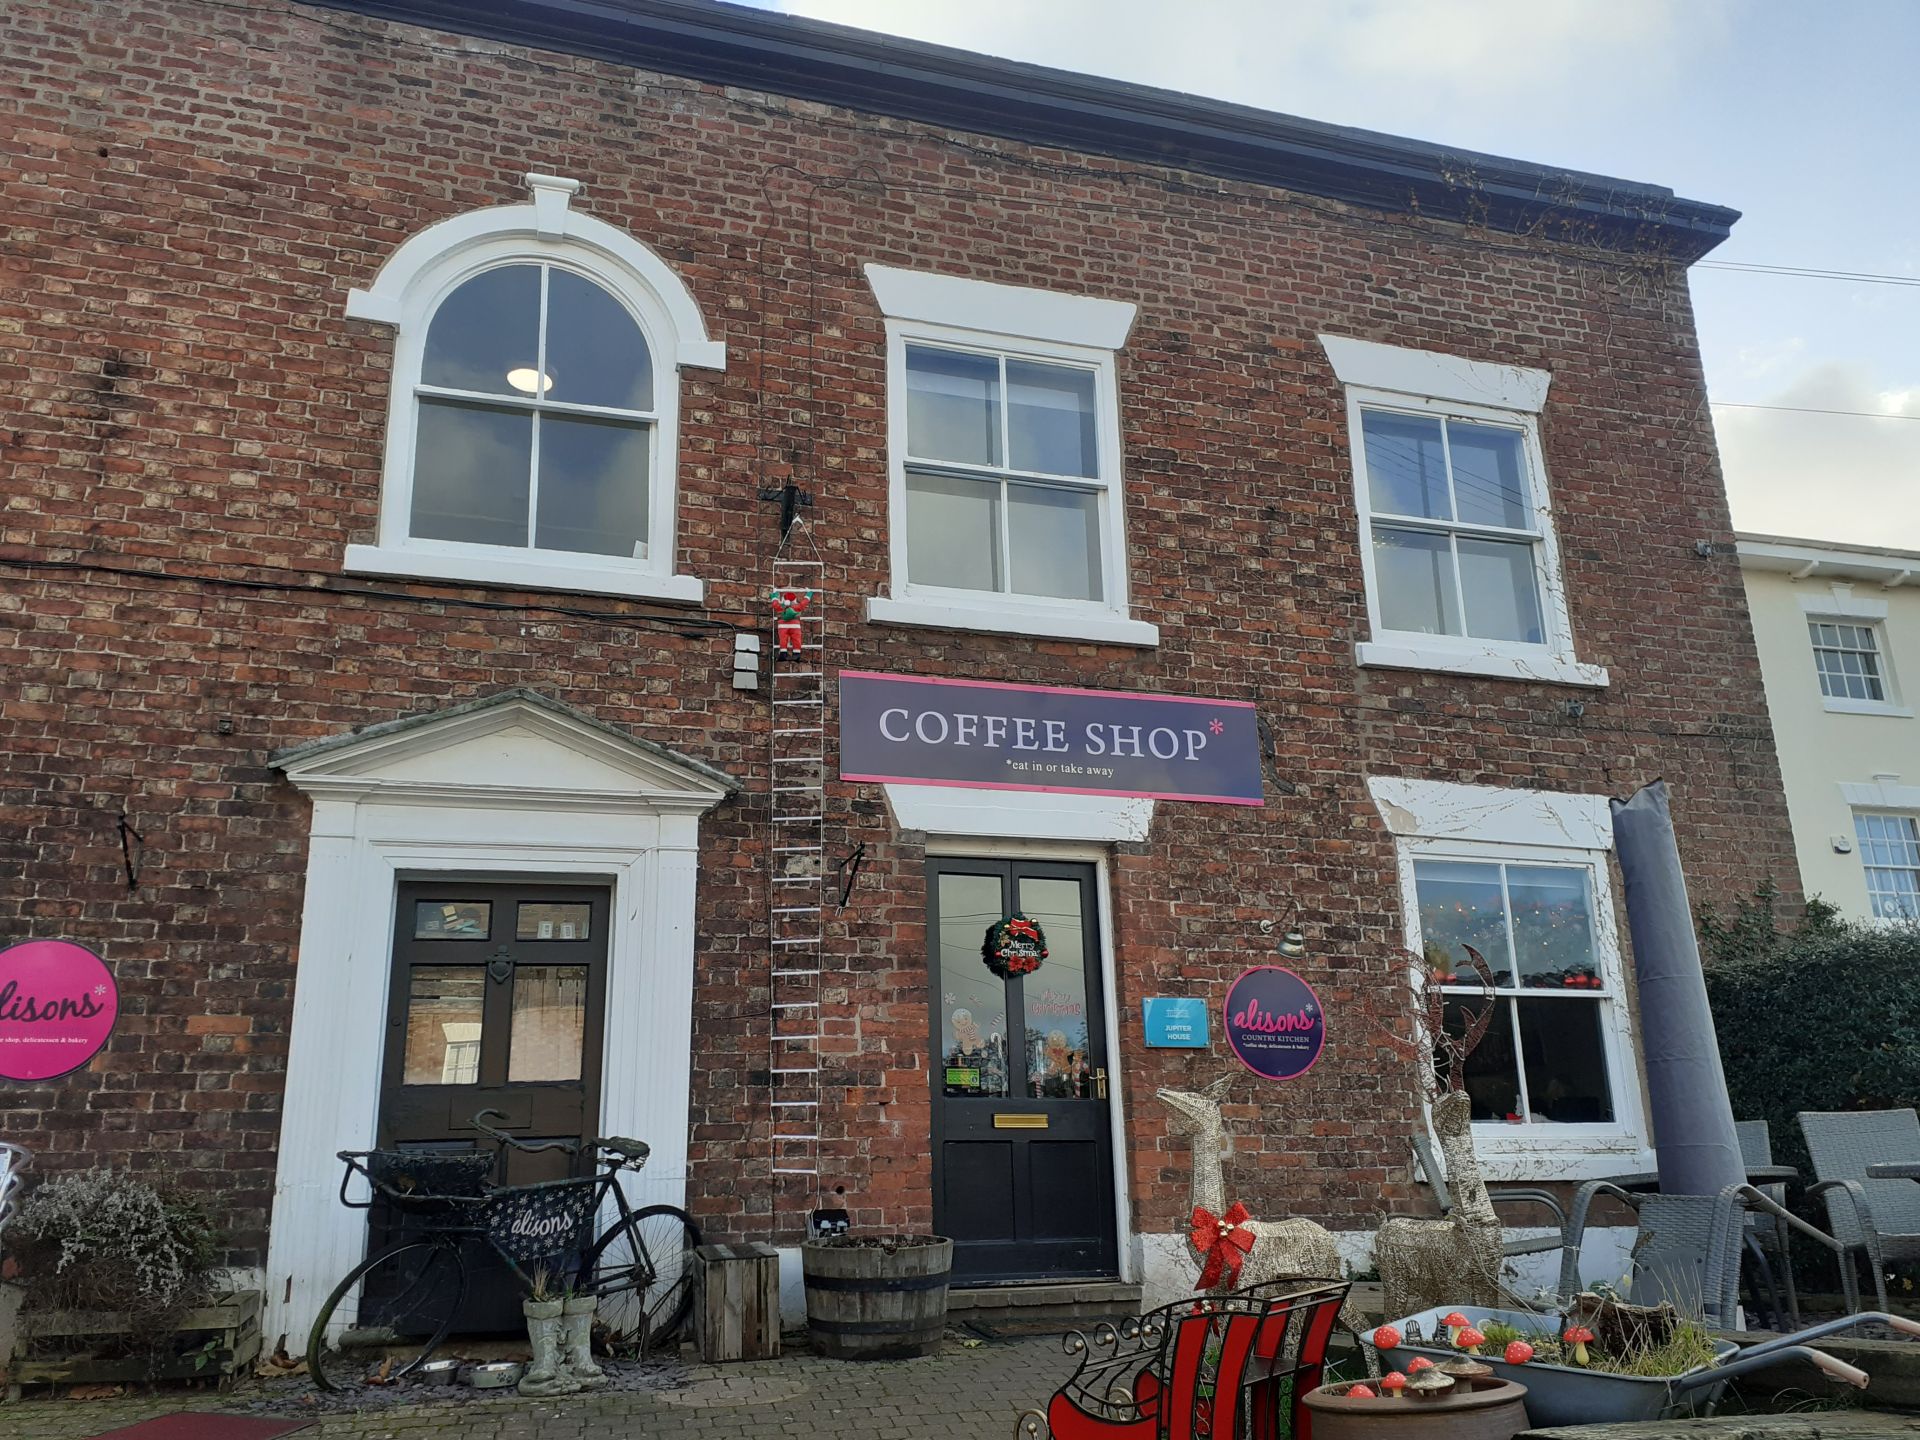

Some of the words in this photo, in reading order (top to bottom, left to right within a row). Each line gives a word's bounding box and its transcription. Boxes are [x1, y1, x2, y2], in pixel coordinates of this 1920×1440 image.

[879, 708, 1070, 753] COFFEE
[1032, 760, 1043, 771] in
[1046, 764, 1058, 772] or
[1061, 763, 1084, 774] take
[1086, 766, 1114, 778] away
[1009, 940, 1035, 951] Merry
[0, 980, 104, 1023] lisons
[1234, 998, 1315, 1033] alisons
[67, 1037, 88, 1045] bakery
[1241, 1034, 1276, 1042] COUNTRY
[1277, 1035, 1310, 1043] KITCHEN
[511, 1208, 573, 1237] alisons
